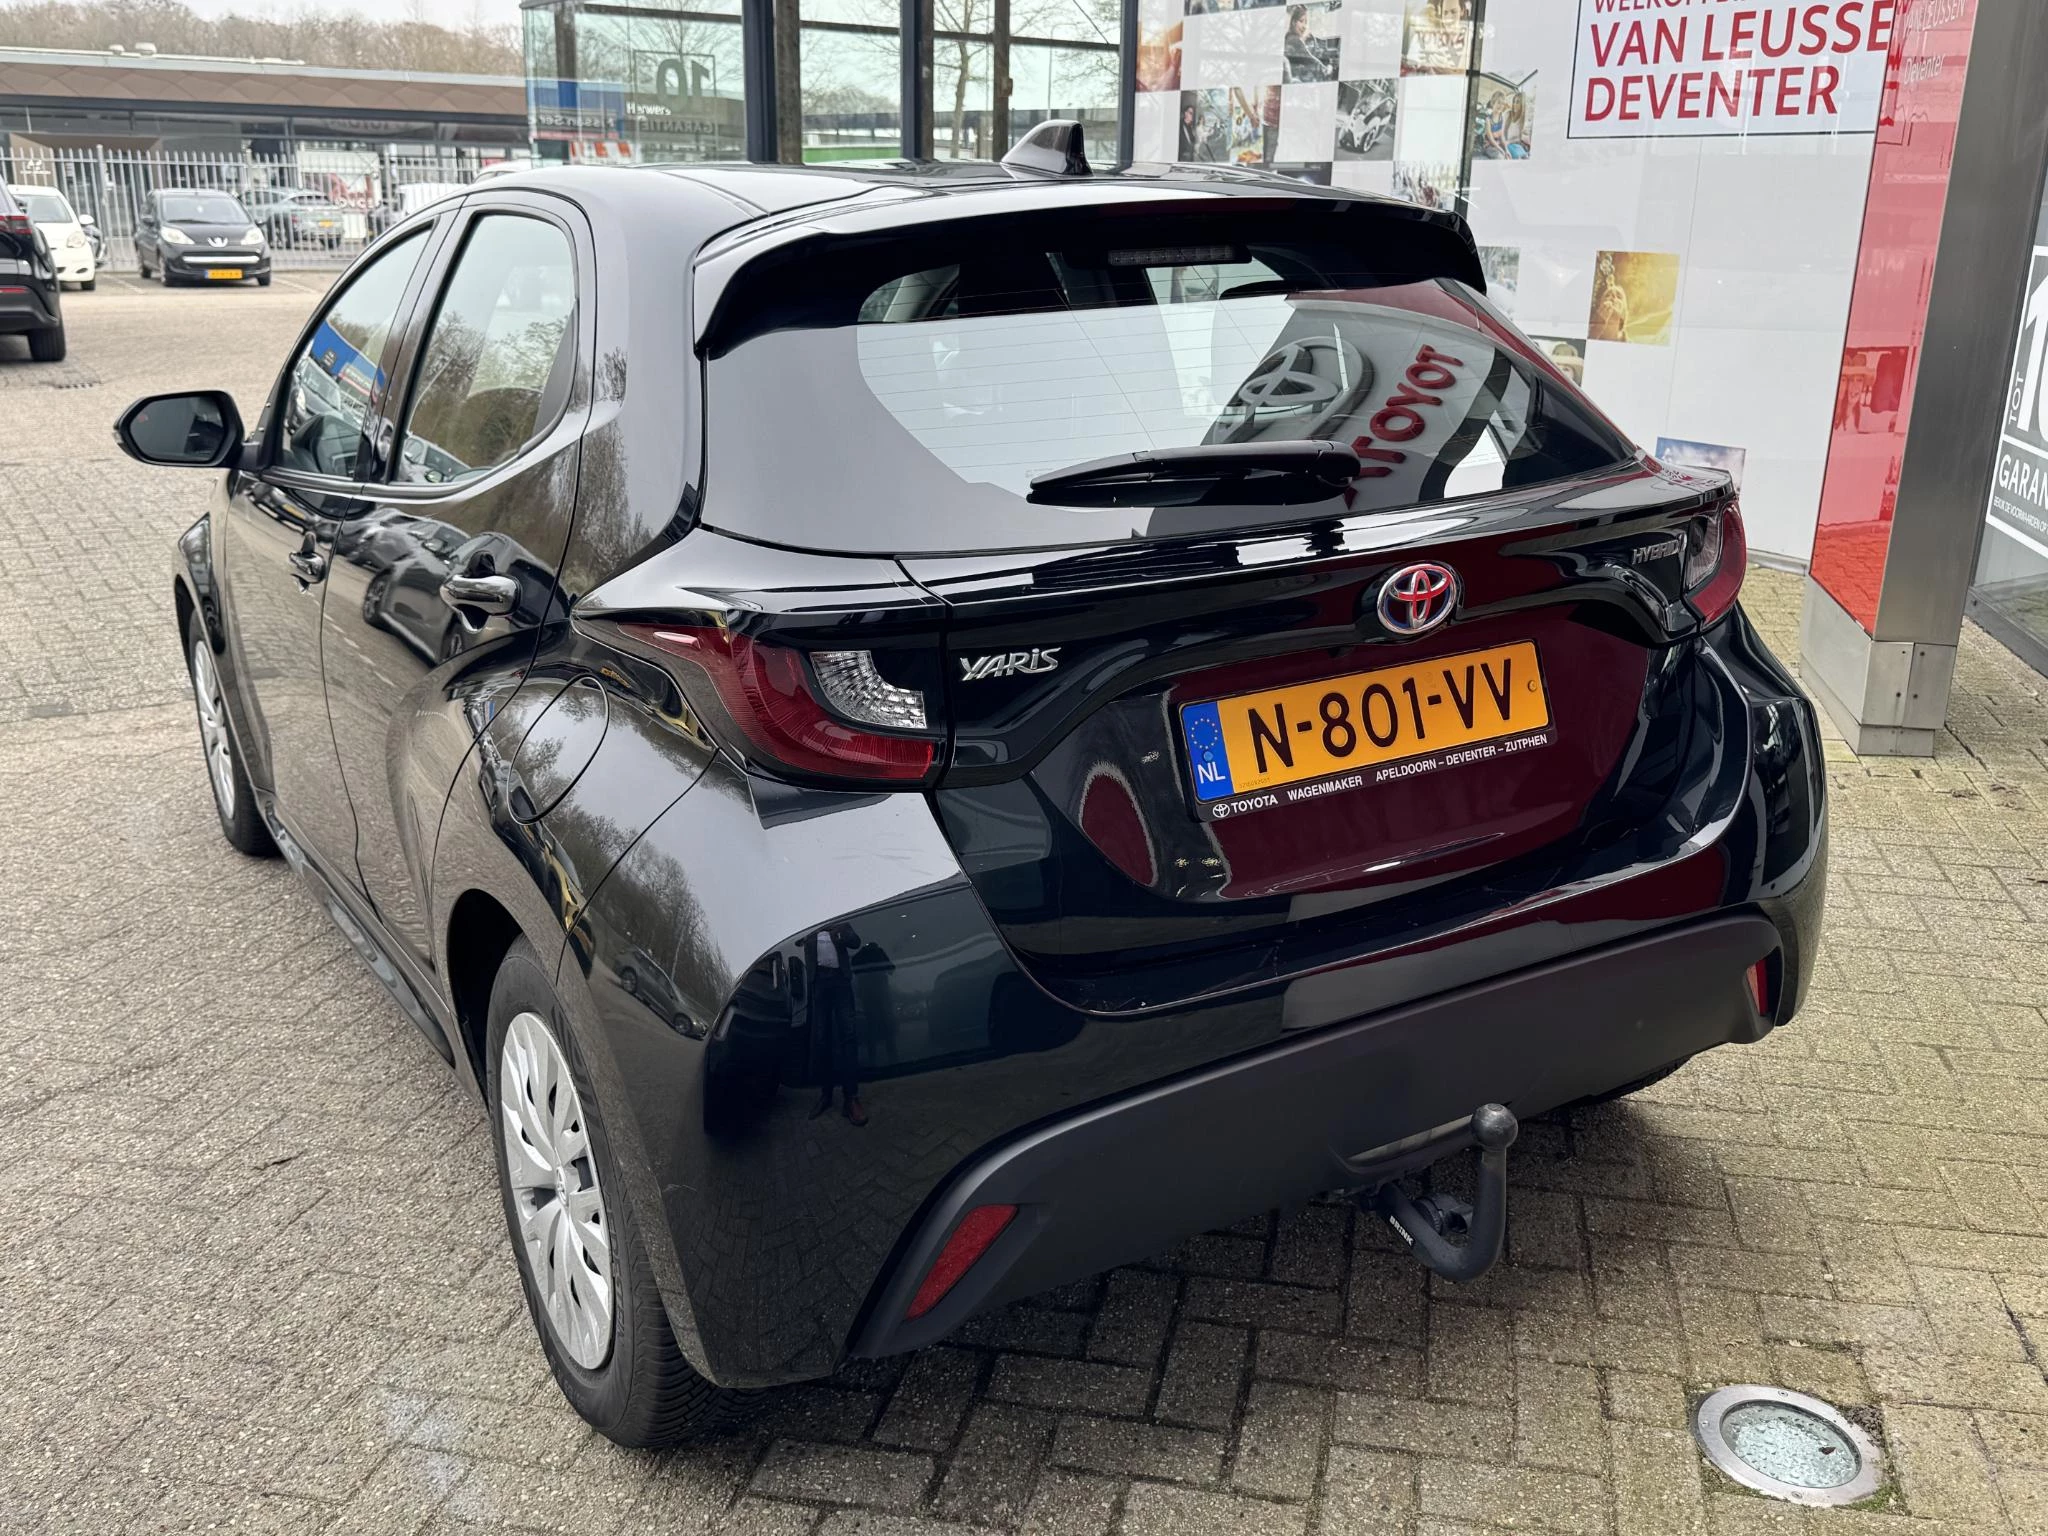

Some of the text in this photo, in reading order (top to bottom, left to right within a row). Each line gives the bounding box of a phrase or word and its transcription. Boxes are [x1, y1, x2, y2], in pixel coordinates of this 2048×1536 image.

[1590, 16, 1688, 67] VAN
[1584, 65, 1840, 122] DEVENTER
[2008, 371, 2024, 425] TOT
[1631, 539, 1680, 565] HYBRID
[1247, 658, 1512, 774] N-801-VV
[1197, 761, 1226, 784] NL
[1231, 794, 1278, 814] TOYOTA
[1286, 775, 1363, 801] WAGENMAKER
[1375, 758, 1437, 782] APELDOORN
[1445, 745, 1496, 766] DEVENTER
[1504, 733, 1548, 753] ZUTPHEN
[1389, 1215, 1414, 1246] BRINK
